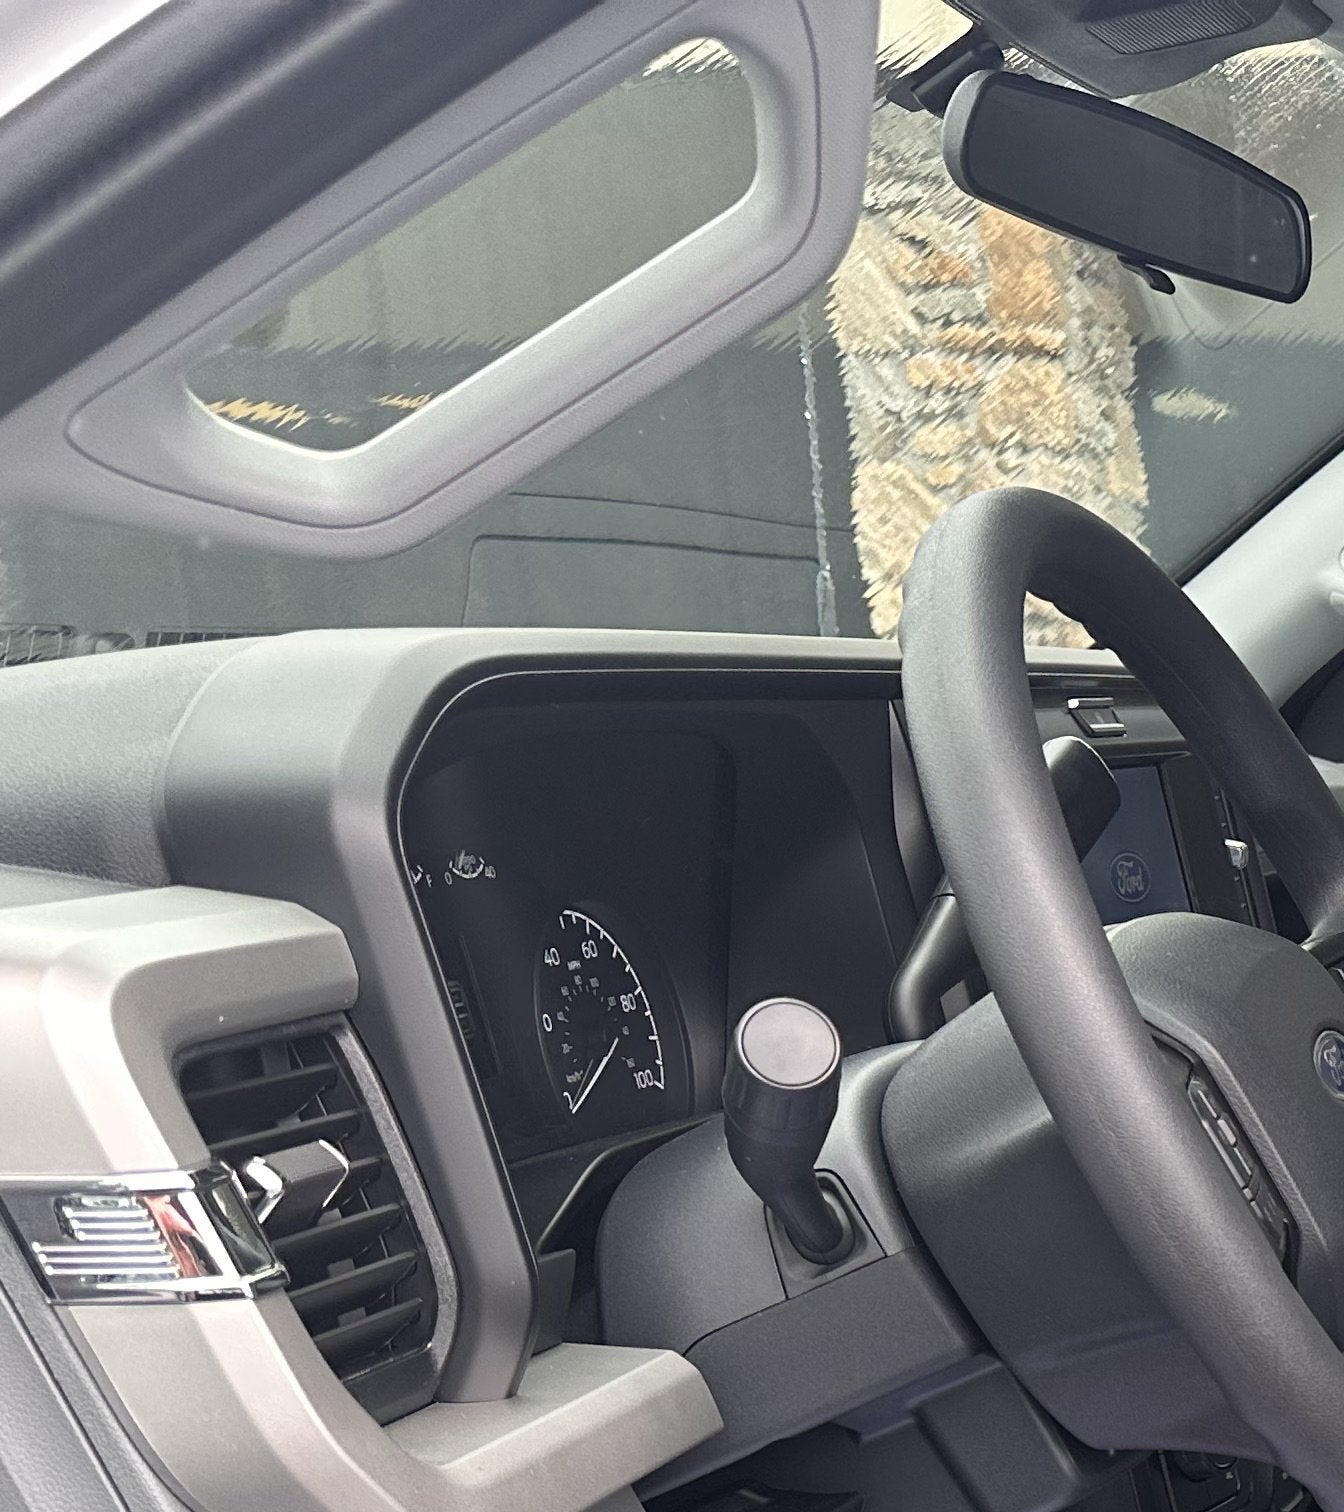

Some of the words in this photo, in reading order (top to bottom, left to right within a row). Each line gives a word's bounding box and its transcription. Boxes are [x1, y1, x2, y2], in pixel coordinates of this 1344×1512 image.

[543, 947, 561, 967] 40
[580, 940, 598, 959] 60
[619, 994, 637, 1013] 80
[632, 1069, 654, 1089] 100
